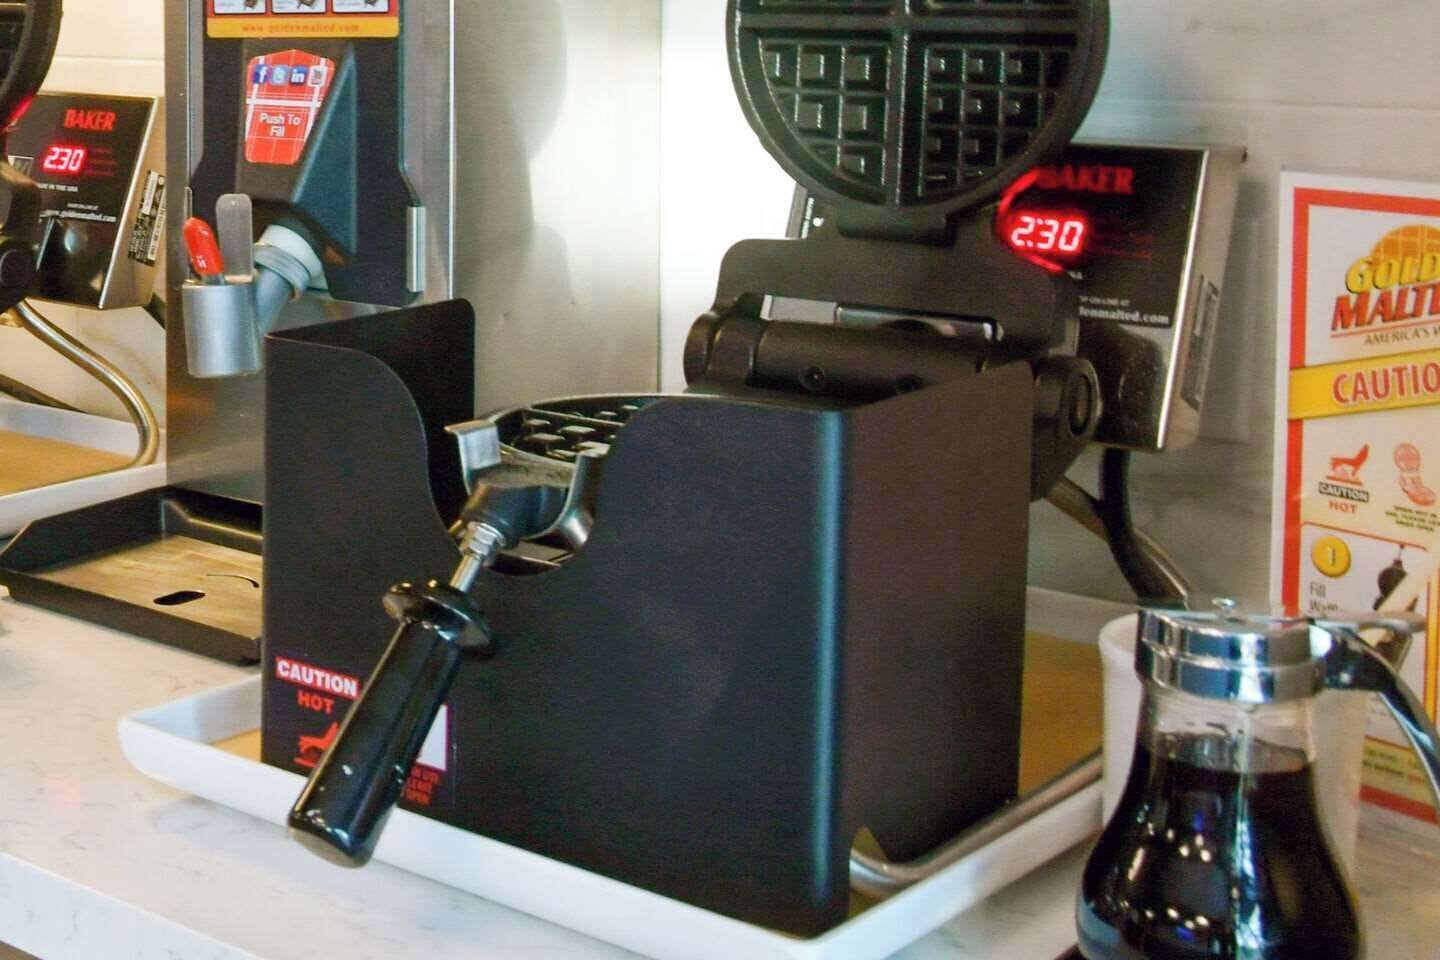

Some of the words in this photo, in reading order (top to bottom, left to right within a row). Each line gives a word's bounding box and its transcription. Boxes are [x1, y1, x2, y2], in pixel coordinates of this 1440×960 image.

[64, 108, 116, 132] BAKER
[259, 112, 286, 125] Push
[288, 113, 301, 125] To
[270, 125, 285, 137] Fill
[43, 146, 84, 172] 230
[1037, 163, 1134, 195] BAKER
[1011, 215, 1084, 252] 2:30
[1364, 327, 1430, 345] AMERICA'S
[1320, 483, 1368, 502] CAUTION
[1329, 499, 1358, 514] HOT
[1327, 545, 1336, 567] 1
[1310, 582, 1326, 598] Fill
[277, 658, 358, 698] CAUTION
[296, 689, 335, 716] HOT
